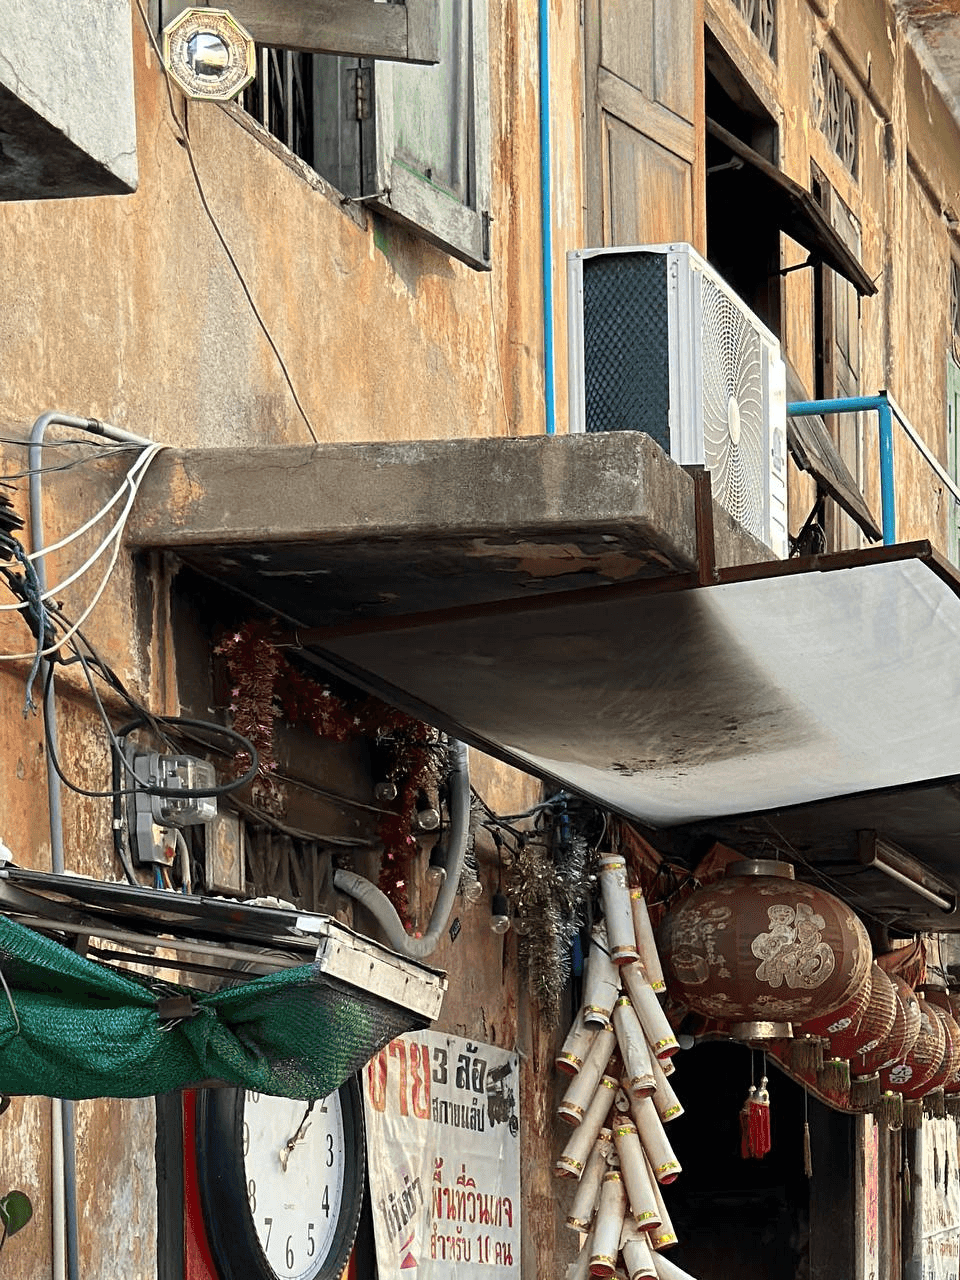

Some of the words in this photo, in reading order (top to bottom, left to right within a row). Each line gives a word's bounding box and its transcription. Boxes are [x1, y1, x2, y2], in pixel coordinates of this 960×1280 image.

[432, 1047, 448, 1085] 3
[456, 1042, 487, 1094] ล้อ
[325, 1134, 334, 1167] 3
[248, 1179, 256, 1214] 8
[321, 1185, 330, 1218] 4
[264, 1218, 273, 1252] 7
[307, 1223, 315, 1256] 5
[285, 1235, 294, 1269] 6
[495, 1241, 513, 1266] คน
